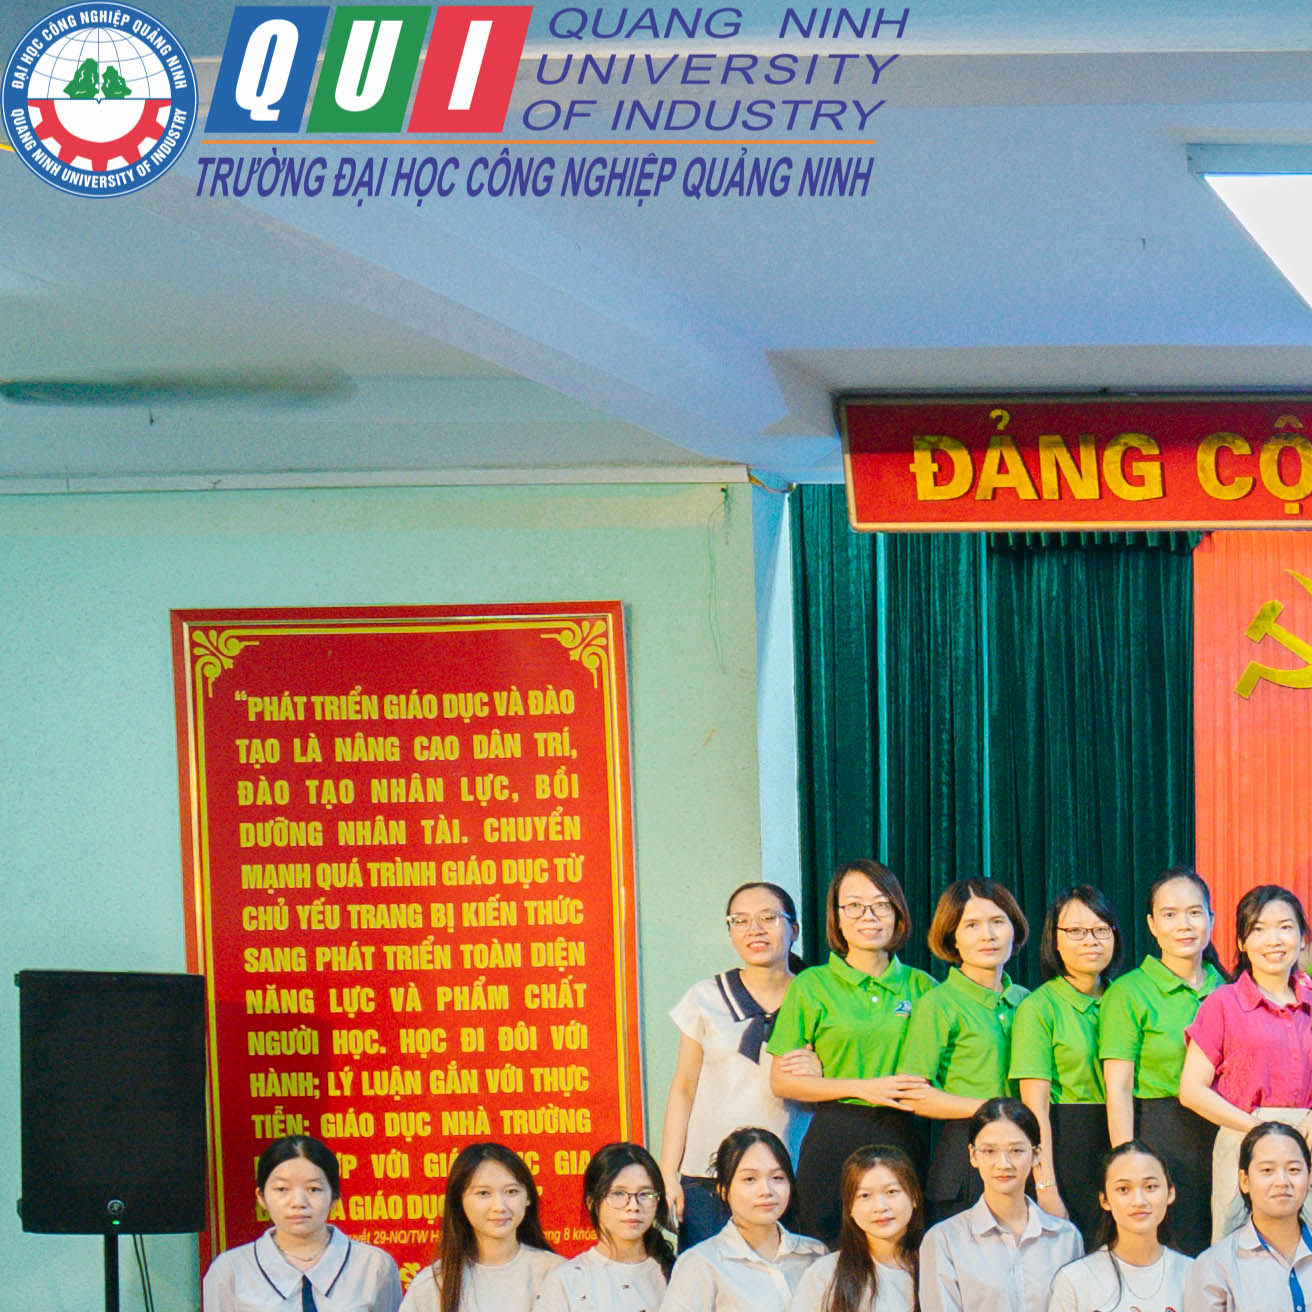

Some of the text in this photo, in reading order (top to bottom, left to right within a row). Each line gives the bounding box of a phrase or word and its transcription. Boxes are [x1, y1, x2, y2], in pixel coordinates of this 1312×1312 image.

[910, 409, 1162, 501] ĐẢNG
[310, 685, 379, 721] TRIỂN
[383, 688, 439, 720] GIÁO
[442, 691, 489, 724] DỤC
[492, 686, 525, 718] VÀ
[526, 684, 576, 717] ĐÀO
[235, 725, 578, 769] TẠO LÀ NÂNG CAO DÂN TRÍ,
[236, 765, 580, 810] ĐÀO TẠO NHÂN LỰC, BỒI
[239, 806, 582, 848] DƯỠNG NHÂN TÀI. CHUYỂN
[240, 851, 586, 895] MẠNH QUÁ TRÌNH GIÁO DỤC TỪ
[242, 893, 585, 934] CHỦ YẾU TRANG BỊ KIẾN THỨC
[563, 1227, 571, 1241] 8
